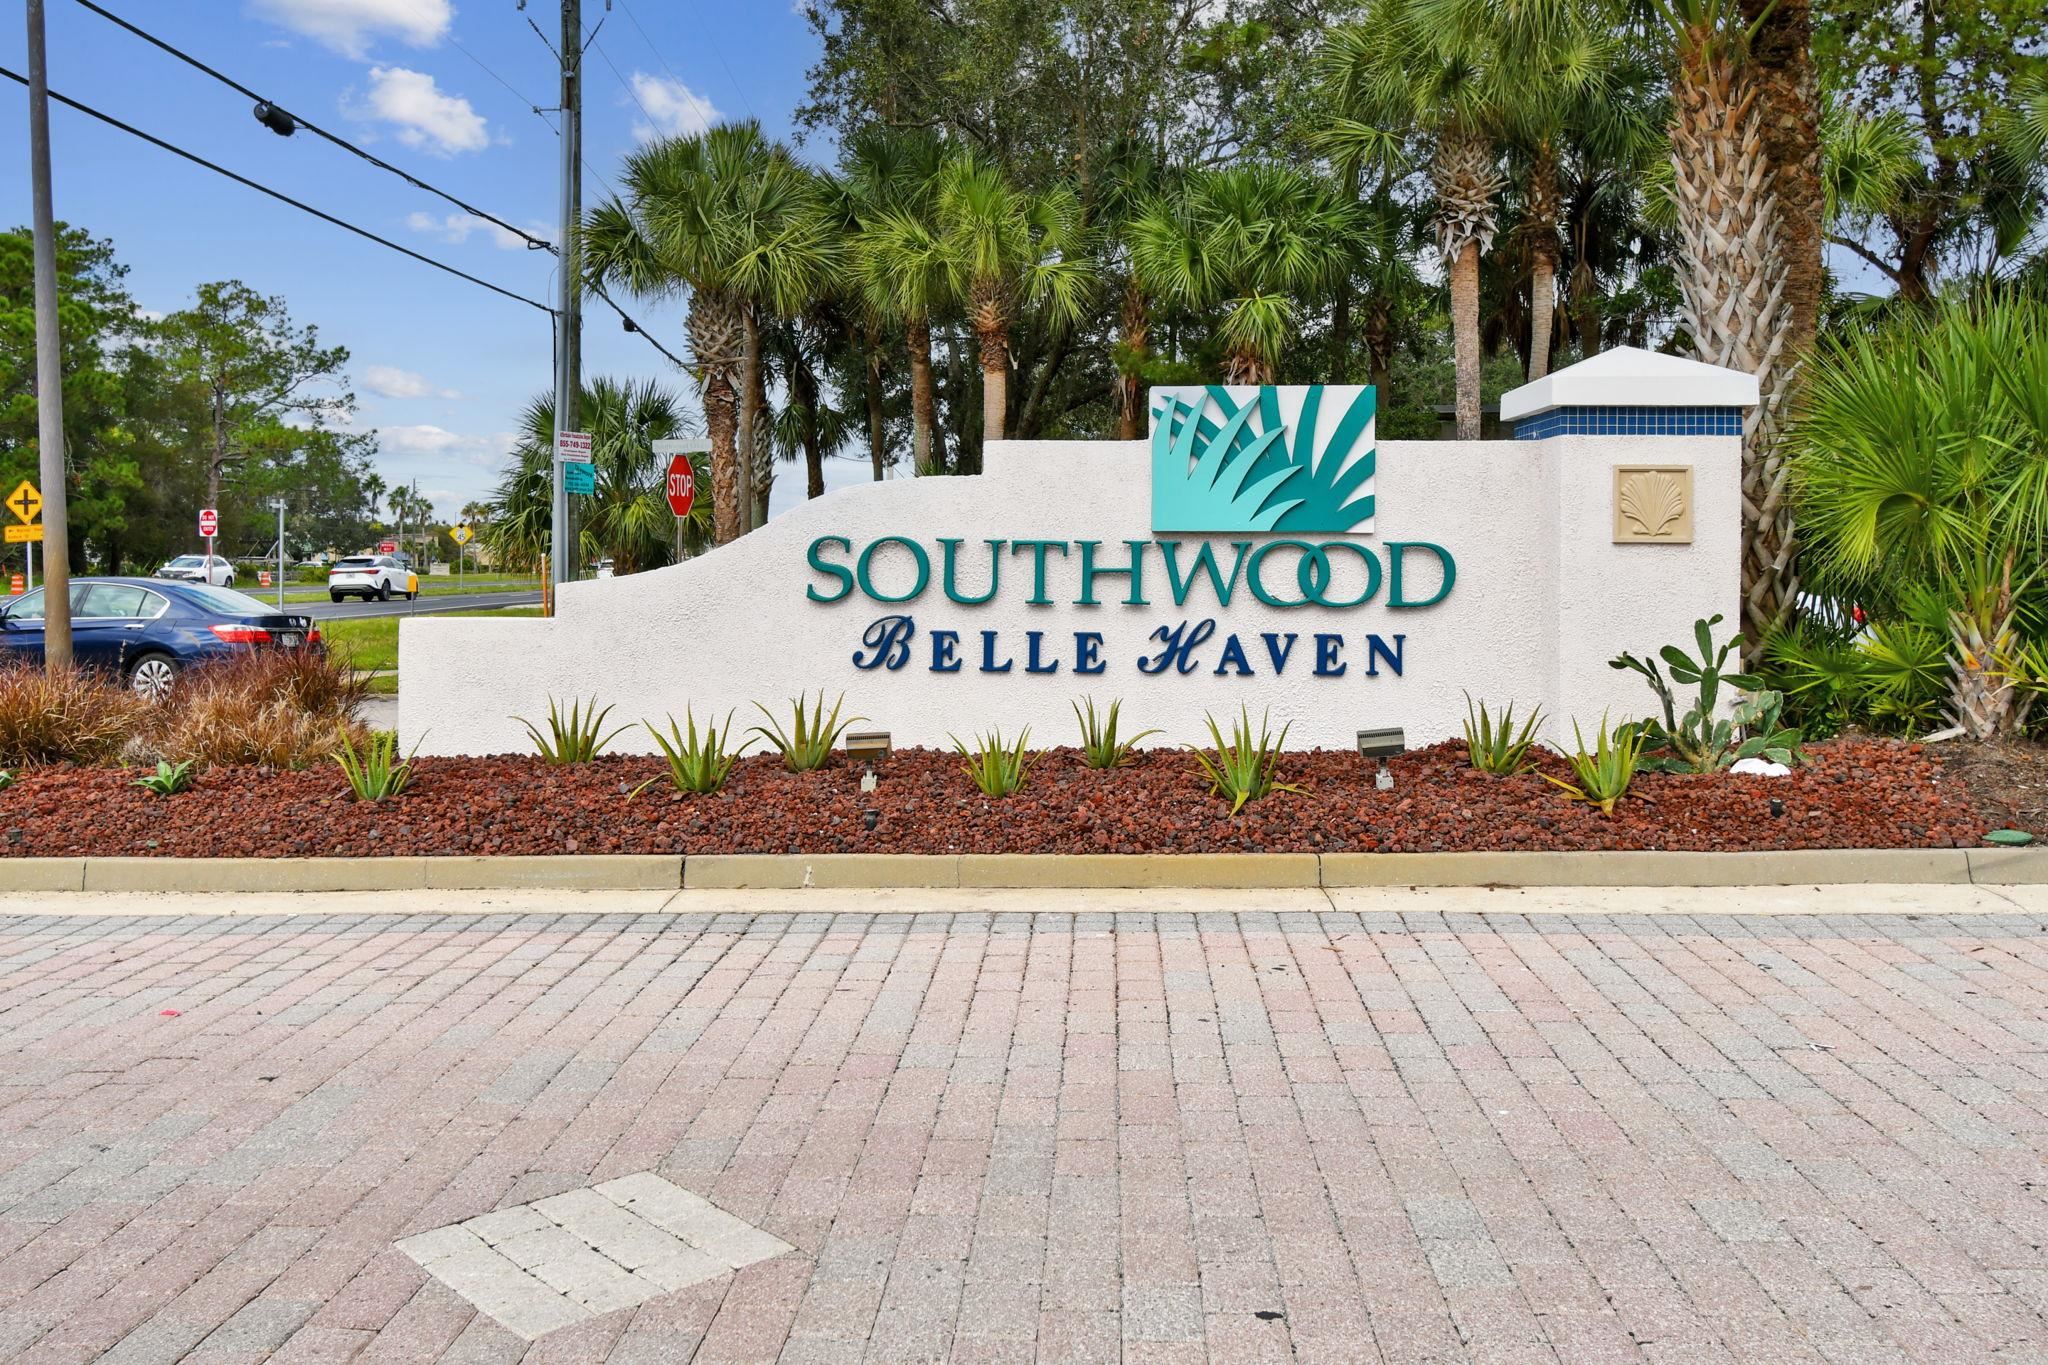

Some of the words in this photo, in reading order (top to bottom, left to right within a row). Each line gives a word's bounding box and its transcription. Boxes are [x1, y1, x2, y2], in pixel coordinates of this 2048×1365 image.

[669, 473, 692, 497] STOP
[806, 535, 1457, 608] SOUTHWOOD
[852, 614, 1107, 674] BELLE
[1137, 618, 1407, 676] HAVEN
